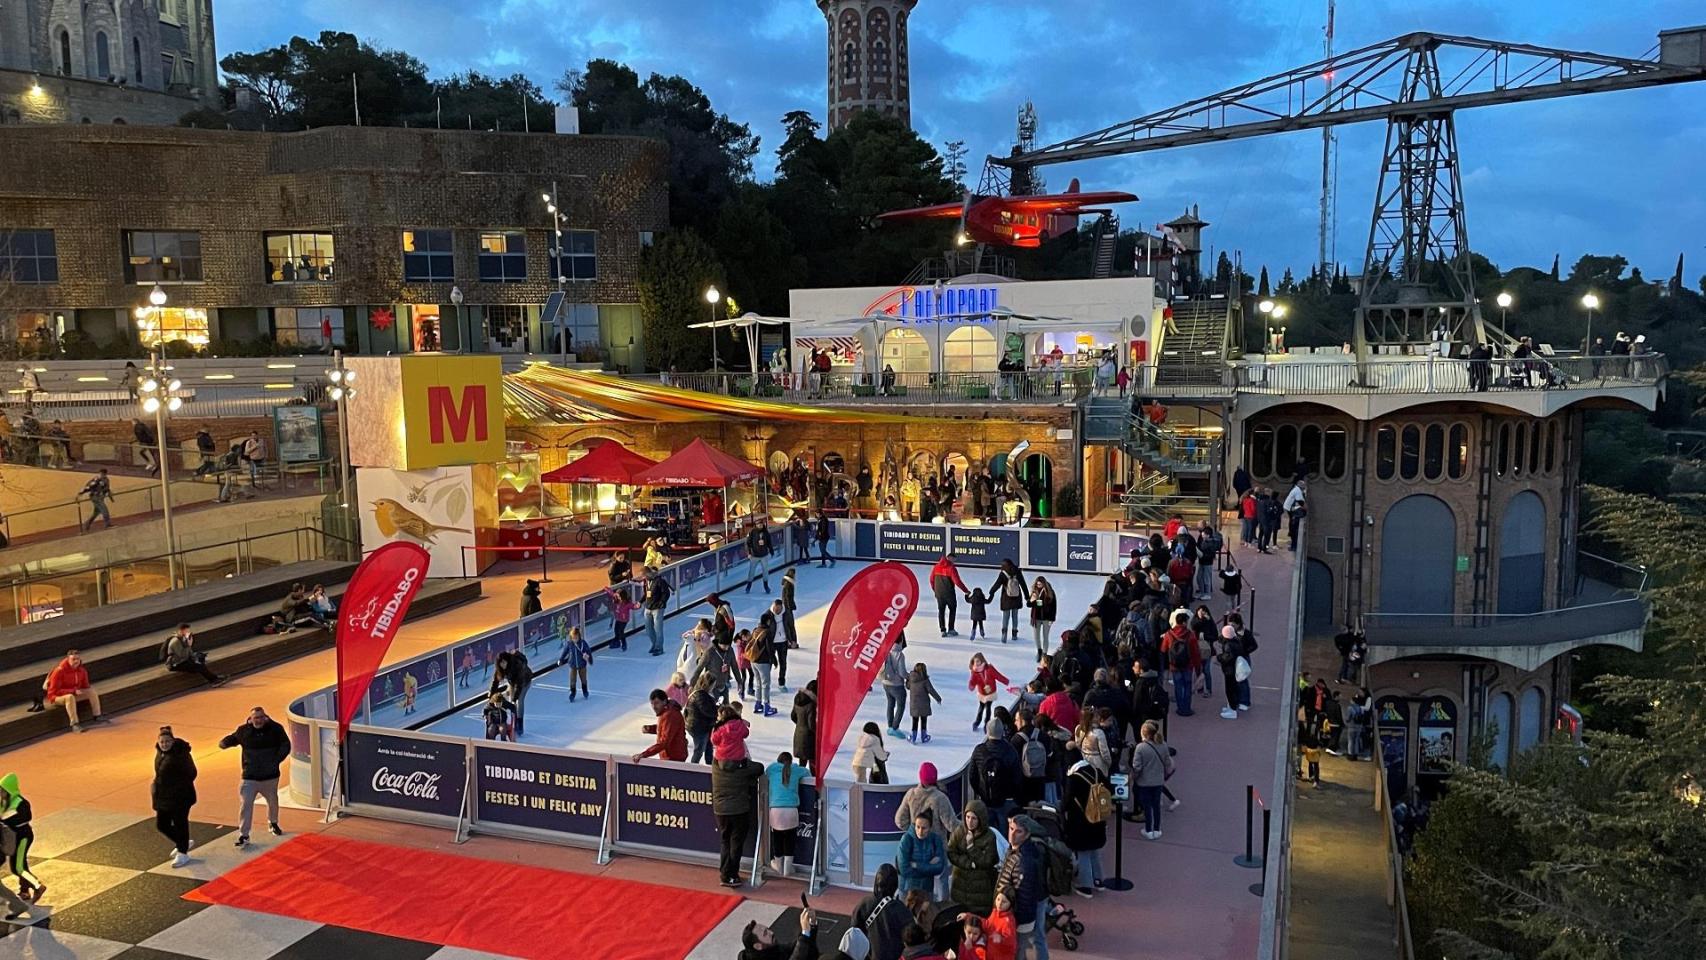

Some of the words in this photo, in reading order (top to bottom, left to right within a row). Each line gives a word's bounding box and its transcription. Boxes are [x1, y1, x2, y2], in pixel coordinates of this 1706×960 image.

[428, 385, 488, 444] M
[370, 567, 419, 639] TIBIDABO
[853, 593, 908, 672] TIBIDABO
[371, 766, 442, 800] Coca-Cola
[484, 765, 535, 782] TIBIDABO
[538, 771, 551, 784] ET
[554, 773, 597, 790] DESITJA
[485, 790, 520, 806] FESTES
[522, 795, 527, 807] I
[530, 796, 546, 810] UN
[549, 799, 577, 815] FELIÇ
[580, 803, 602, 817] ANY
[626, 783, 656, 798] UNES
[660, 786, 713, 805] MÀGIQUE
[626, 809, 651, 824] NOU
[655, 813, 689, 829] 2024!
